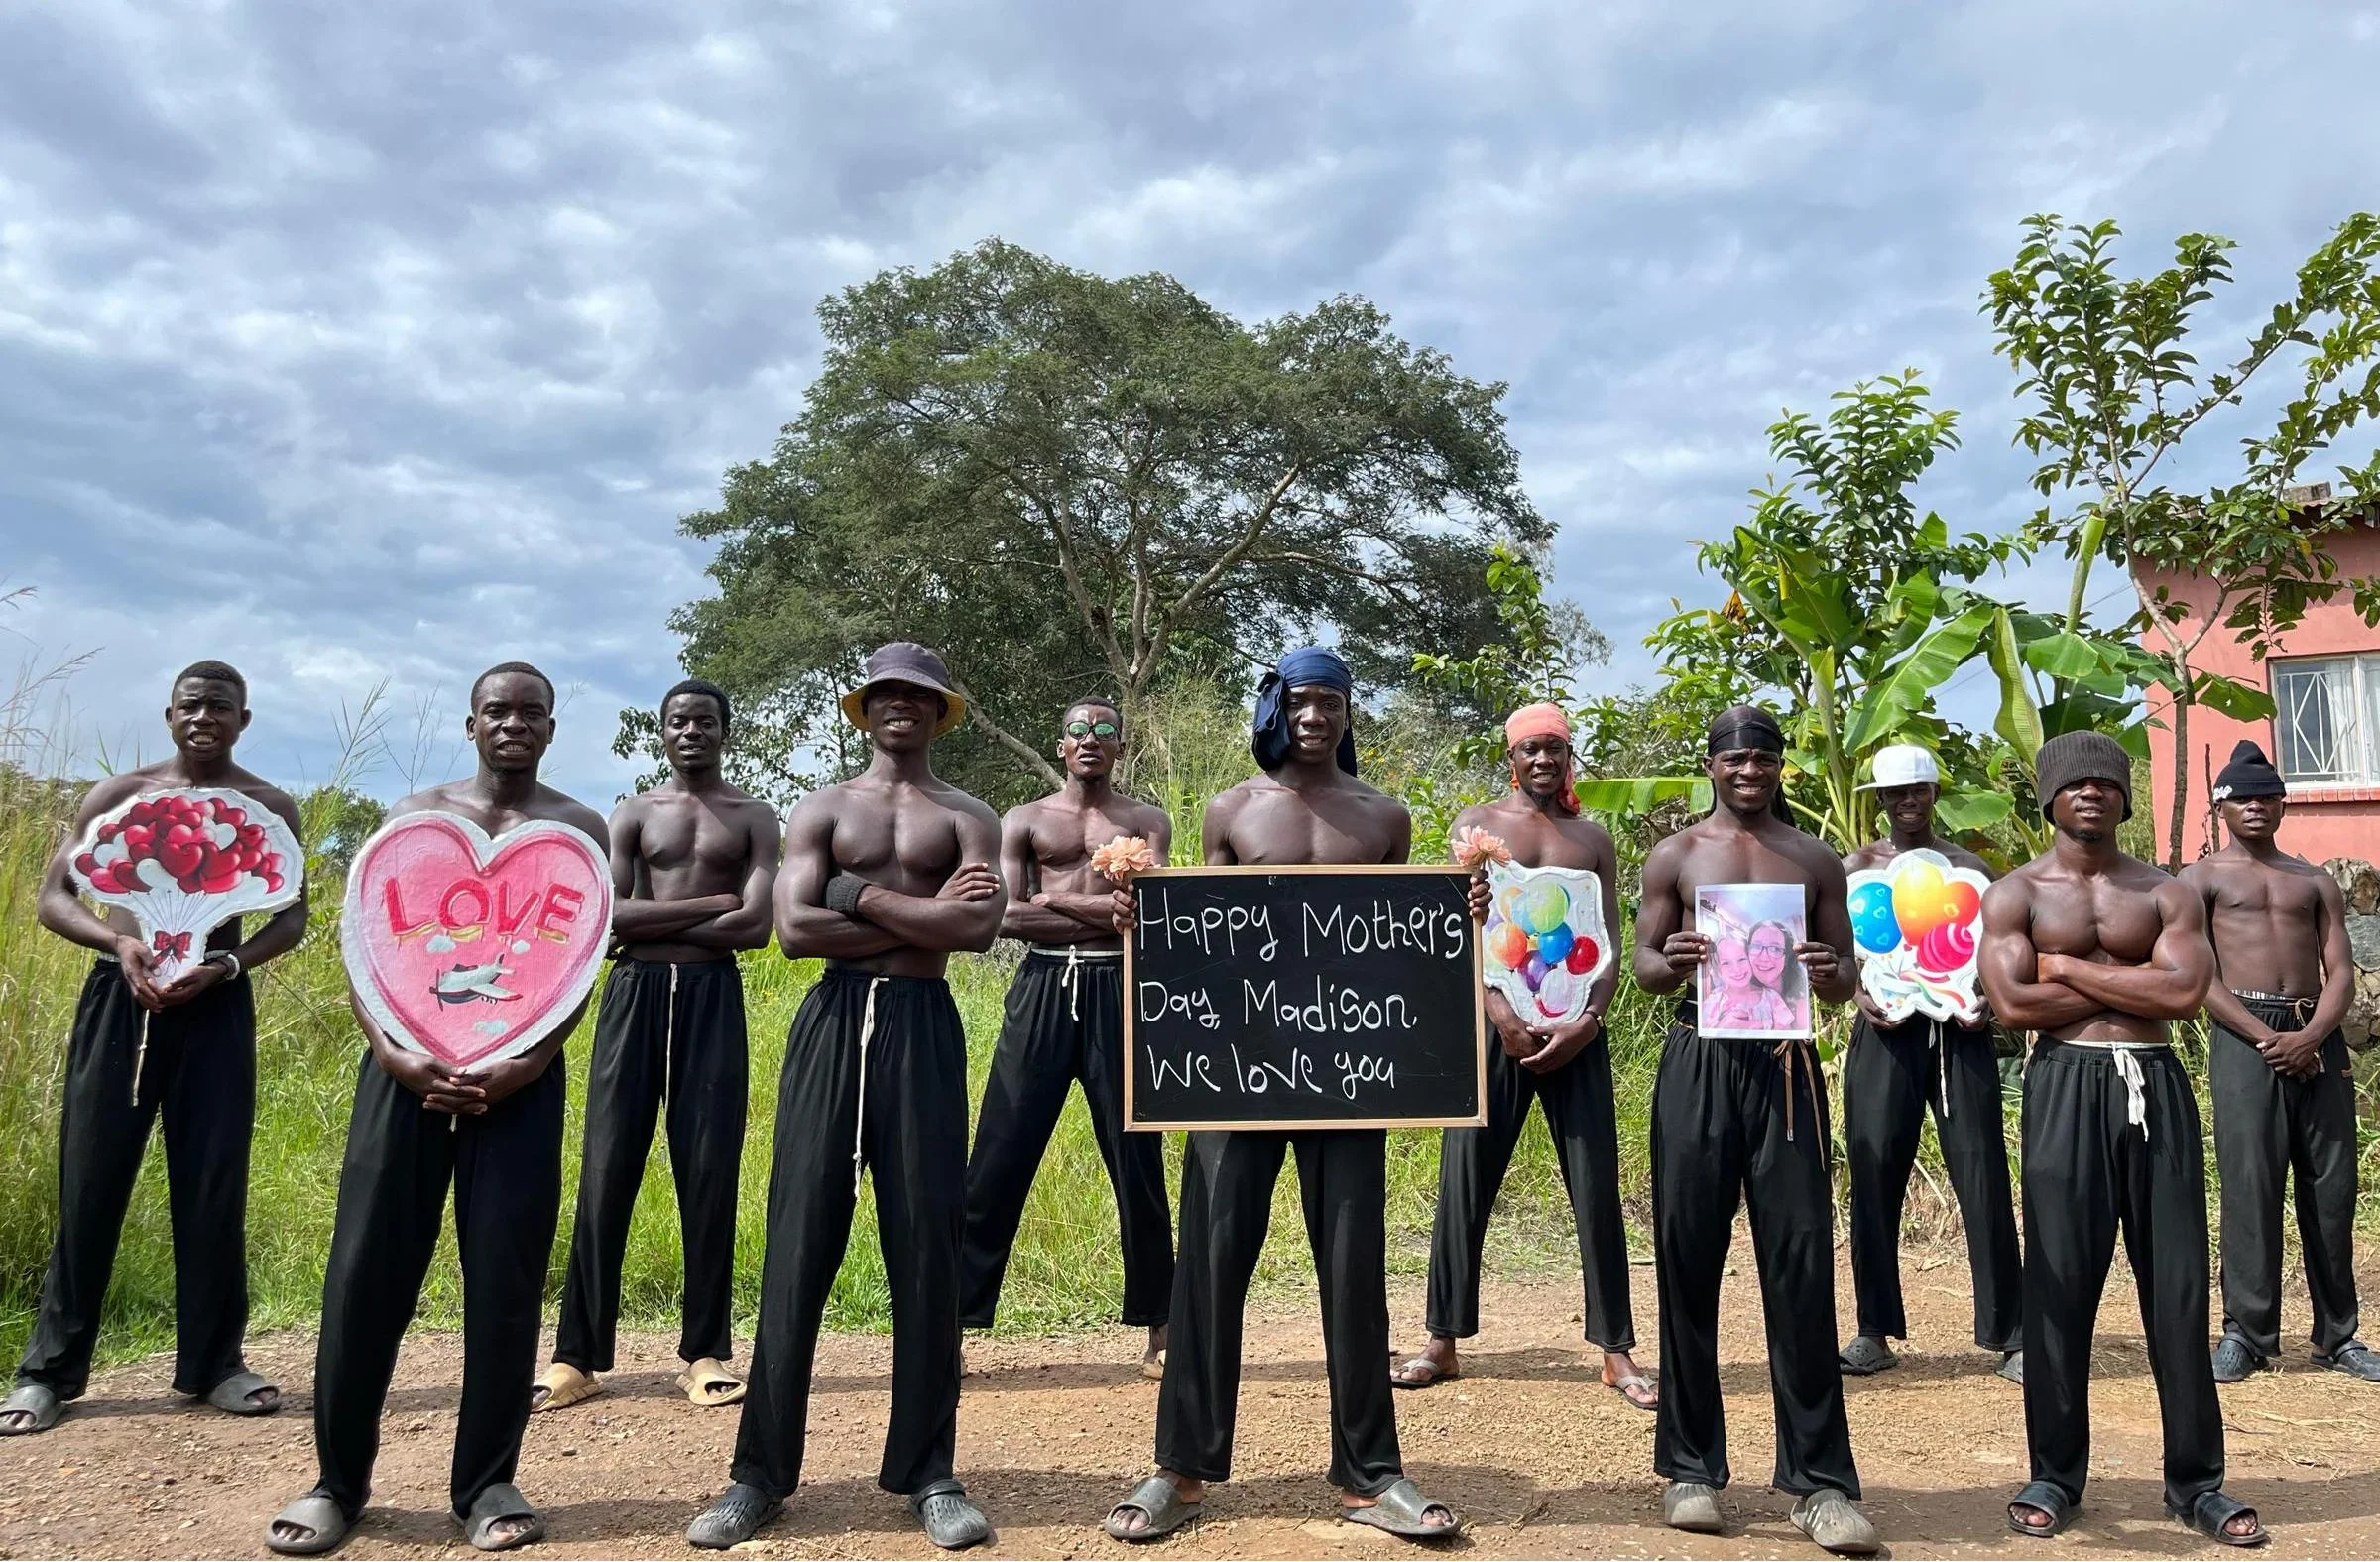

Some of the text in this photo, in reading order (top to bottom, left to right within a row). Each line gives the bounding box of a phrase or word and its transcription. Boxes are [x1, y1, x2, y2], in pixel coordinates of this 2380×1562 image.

[384, 877, 585, 942] LOVE
[1139, 887, 1463, 961] Happy Mother's
[1147, 1043, 1395, 1100] We love you
